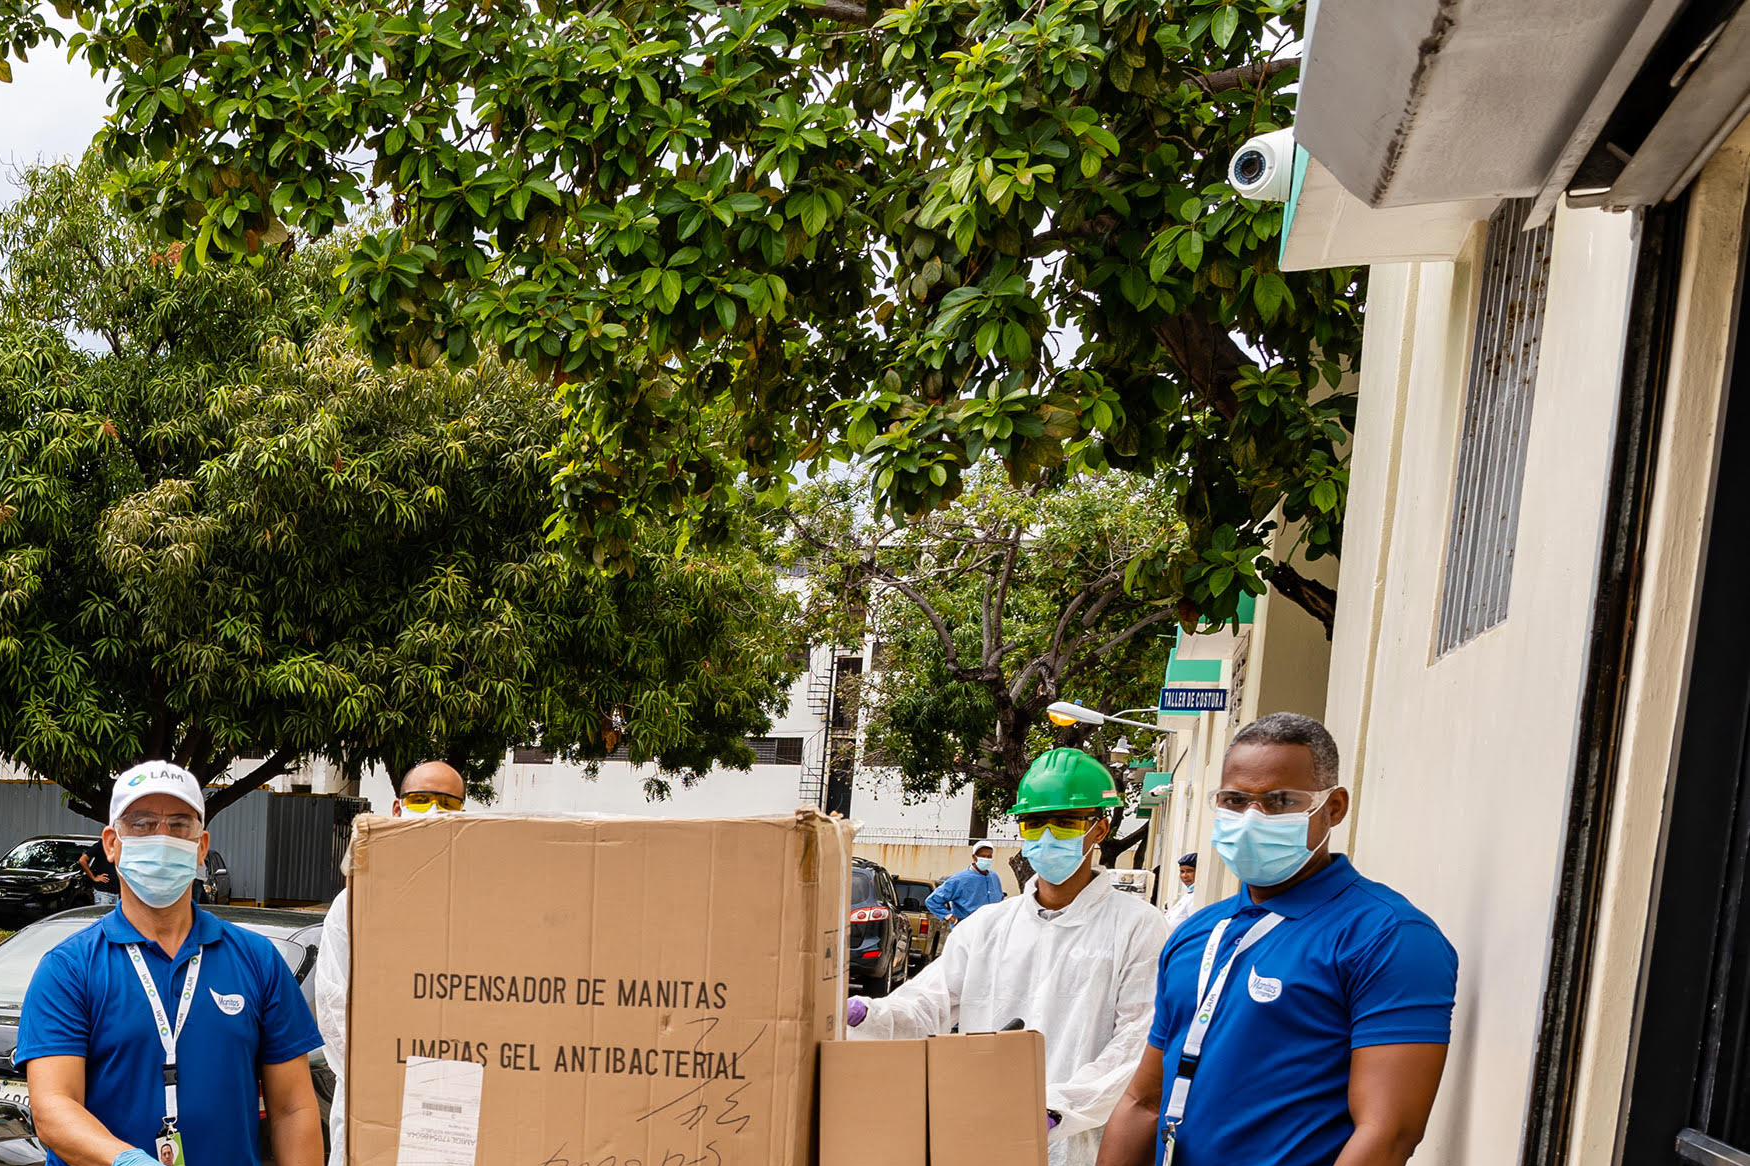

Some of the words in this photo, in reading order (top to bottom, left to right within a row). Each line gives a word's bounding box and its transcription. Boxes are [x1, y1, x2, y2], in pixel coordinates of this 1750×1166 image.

[1164, 692, 1186, 708] TALLER
[1186, 692, 1195, 708] DE
[1195, 692, 1223, 708] COSTURA
[150, 770, 185, 783] LAM
[413, 972, 567, 1005] DISPENSADOR
[576, 978, 607, 1006] DE
[617, 979, 728, 1010] MANITAS
[1204, 993, 1217, 1012] LAM
[396, 1038, 489, 1068] LIMPIAS
[499, 1042, 540, 1072] GEL
[553, 1045, 746, 1080] ANTIBACTERIAL
